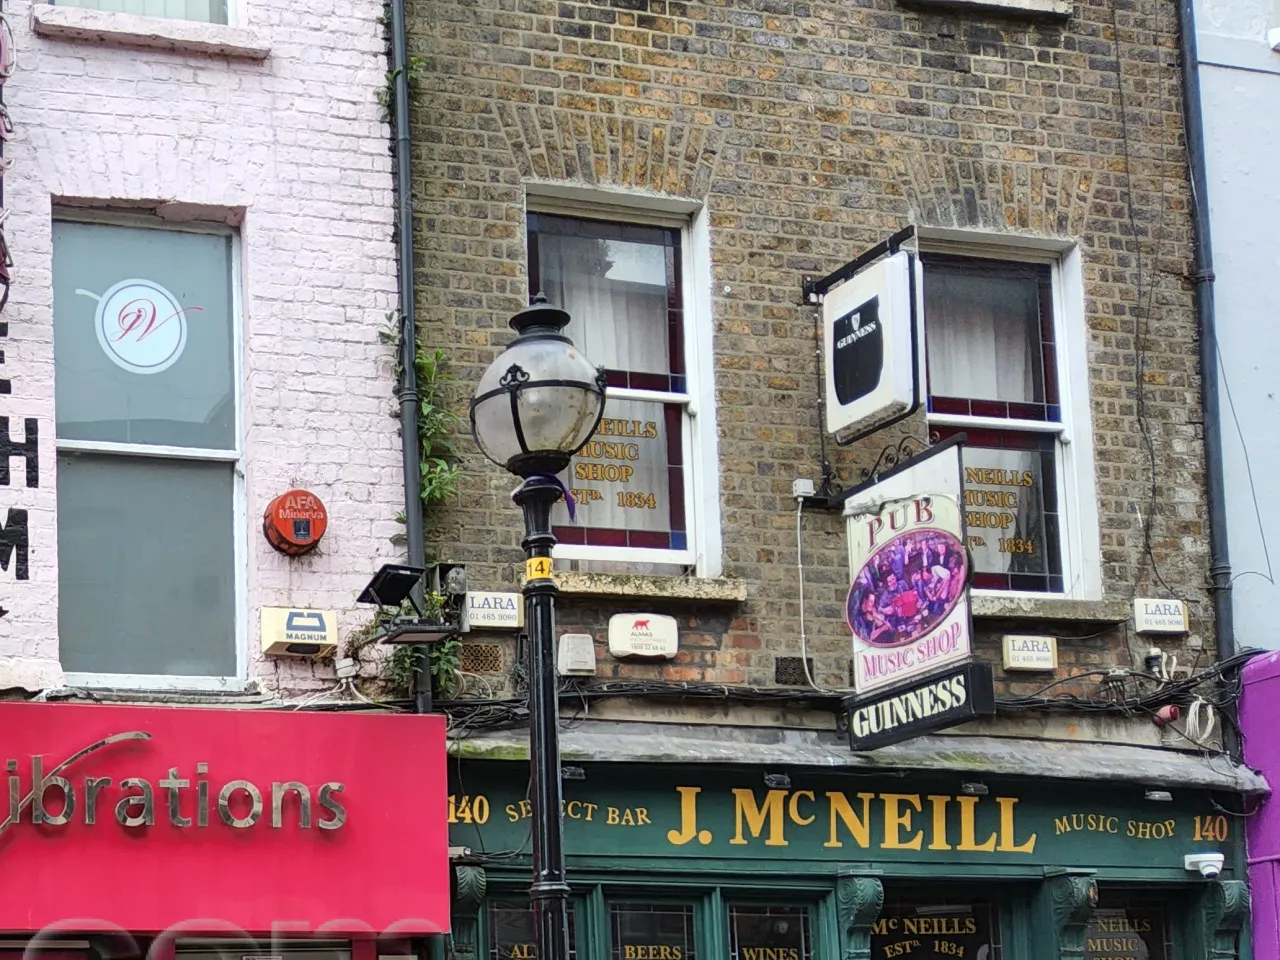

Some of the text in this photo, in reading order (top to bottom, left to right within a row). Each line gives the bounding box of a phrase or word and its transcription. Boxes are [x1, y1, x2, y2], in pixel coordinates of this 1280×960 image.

[836, 320, 877, 350] GUINNESS
[595, 418, 658, 439] EILLS
[575, 463, 634, 482] SHOP
[965, 467, 1034, 487] NEILLS
[285, 495, 318, 510] AFA
[278, 508, 324, 519] Minerva
[867, 498, 936, 552] PUB
[469, 596, 516, 610] LARA
[1144, 603, 1183, 616] LARA
[469, 612, 479, 620] 01
[285, 632, 328, 641] MAGNUM
[863, 621, 963, 683] MUSIC SHOP
[1011, 639, 1051, 653] LARA
[852, 674, 967, 738] GUINNESS
[448, 794, 490, 825] 140
[505, 798, 598, 823] SECT
[606, 806, 651, 826] BAR
[667, 786, 713, 846] J.
[1054, 812, 1119, 836] MUSIC
[1126, 818, 1177, 841] SHOP
[1193, 814, 1229, 843] 140
[509, 943, 537, 960] AL
[624, 944, 683, 960] BEERS
[933, 940, 965, 959] 1834
[1087, 938, 1138, 952] MUSIC
